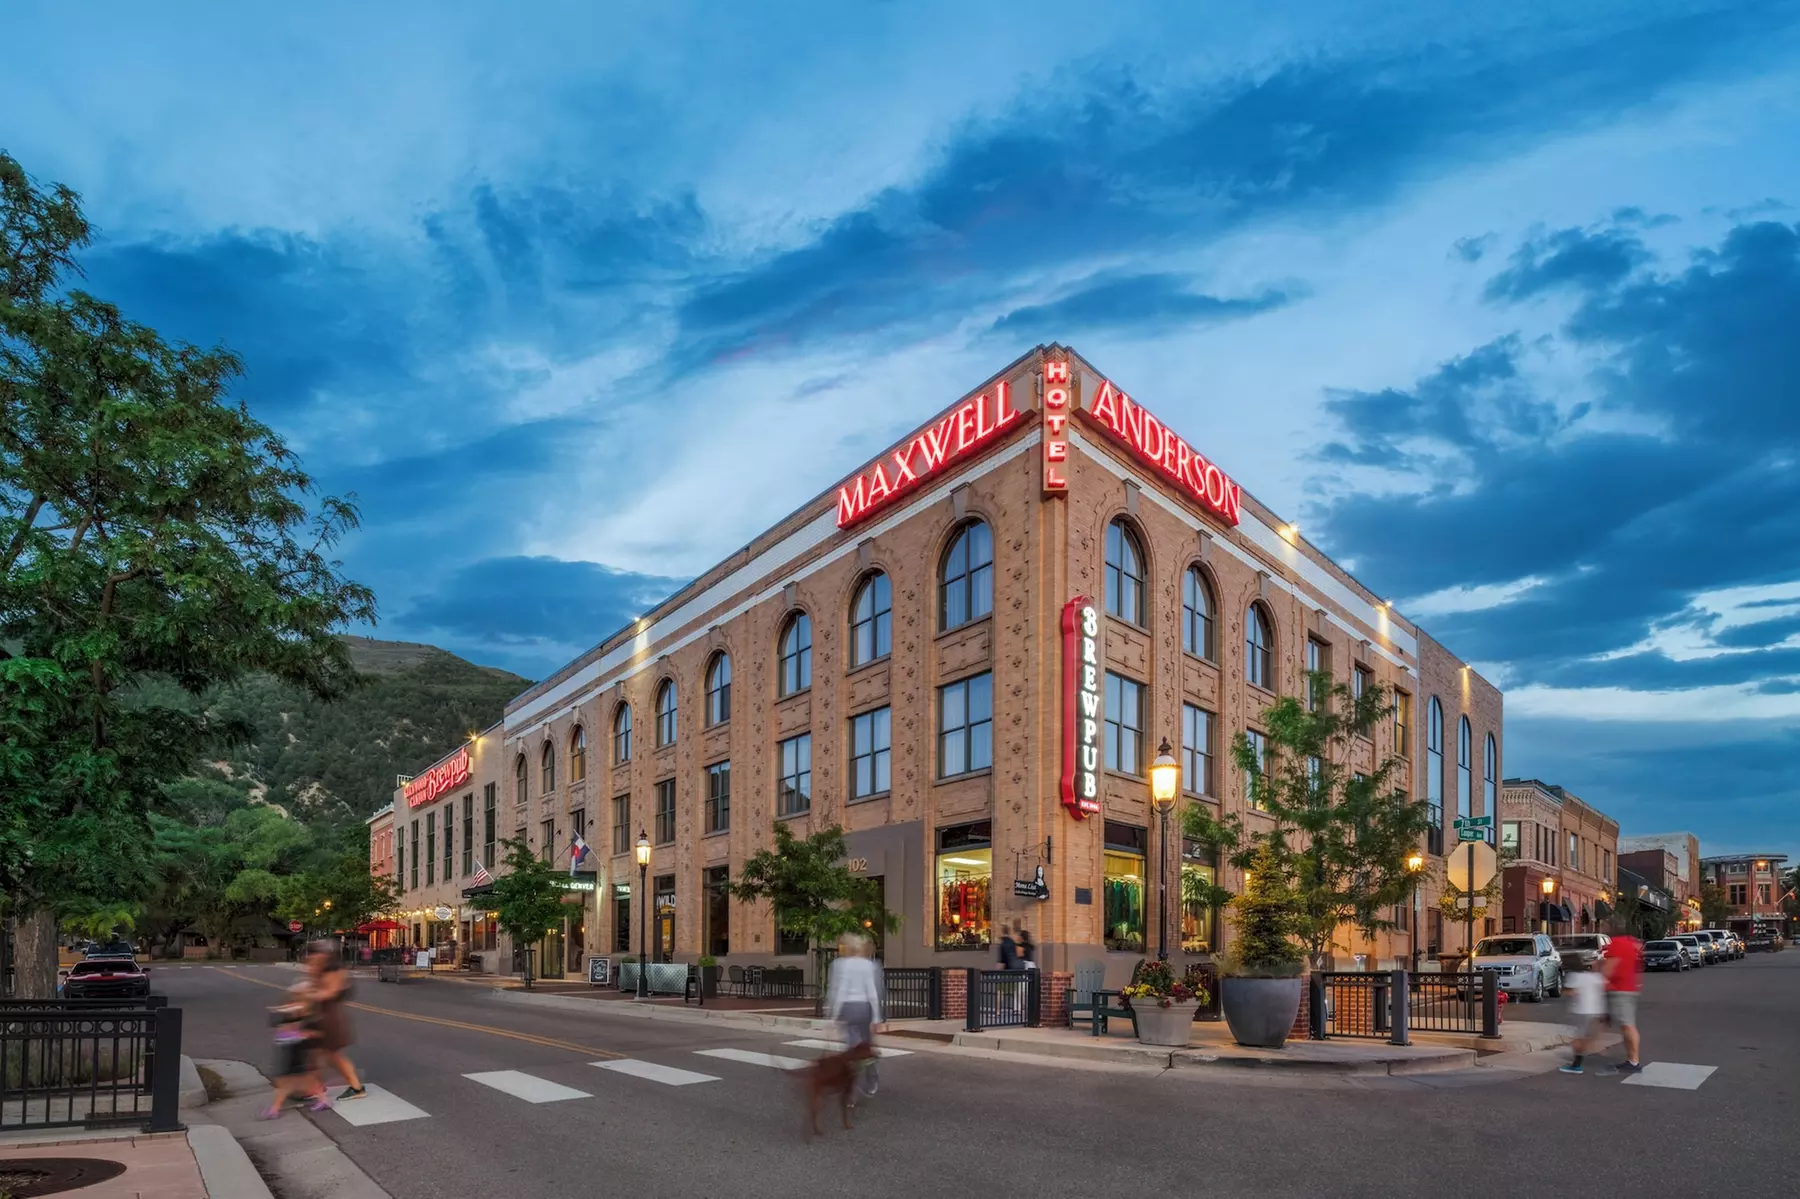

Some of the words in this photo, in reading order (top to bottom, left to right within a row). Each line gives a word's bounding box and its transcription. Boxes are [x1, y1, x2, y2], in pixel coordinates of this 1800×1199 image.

[837, 380, 1017, 526] MAXWELL
[1047, 362, 1066, 487] HOTEL
[1093, 379, 1240, 525] ANDERSON
[1081, 606, 1099, 797] BREWPUB
[427, 747, 468, 801] Brewpub
[570, 882, 594, 890] DENVER
